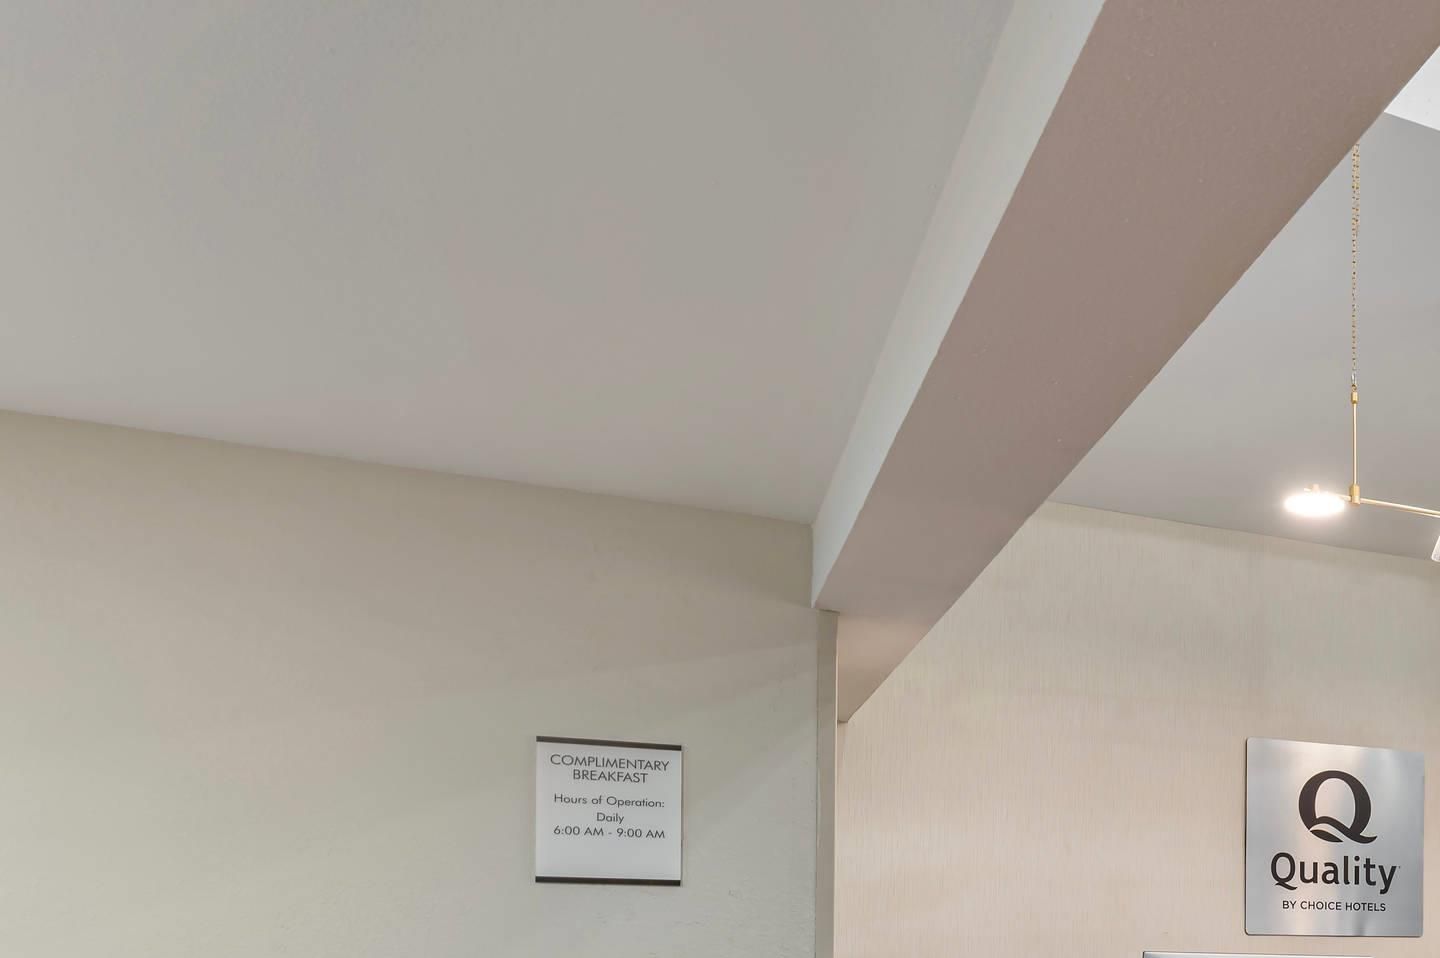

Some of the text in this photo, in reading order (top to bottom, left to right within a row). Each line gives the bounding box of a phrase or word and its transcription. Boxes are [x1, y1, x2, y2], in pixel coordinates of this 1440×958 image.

[550, 753, 670, 772] COMPLIMENTARY
[572, 769, 649, 784] BREAKFAST
[553, 793, 665, 809] Hours of Operation:
[596, 812, 625, 825] Daily
[553, 825, 580, 836] 6:00
[583, 827, 604, 837] AM
[616, 828, 642, 839] 9:00
[645, 829, 666, 839] AM
[1270, 852, 1398, 894] Quality
[1282, 900, 1387, 912] BY CHOICE HOTELS
